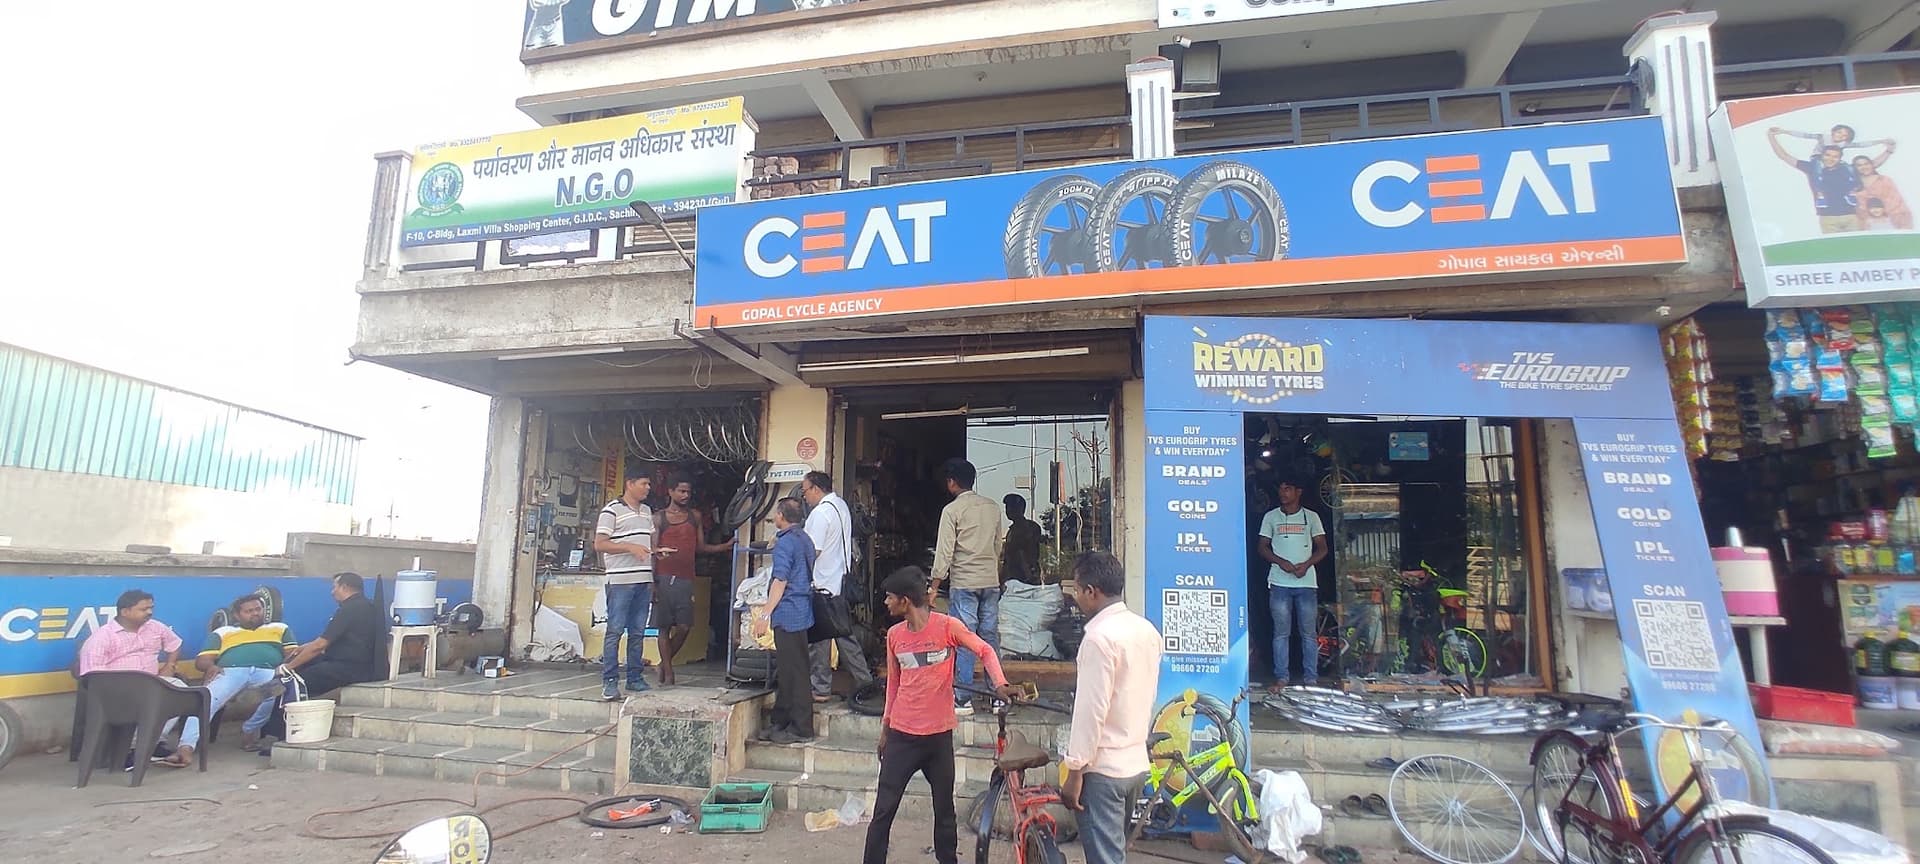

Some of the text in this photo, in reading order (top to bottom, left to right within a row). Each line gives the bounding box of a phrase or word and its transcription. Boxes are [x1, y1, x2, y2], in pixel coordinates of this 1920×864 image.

[473, 120, 737, 178] पर्यावरण और मानव अधिकार संस्था
[1216, 168, 1260, 185] MILAZE
[555, 168, 635, 206] N.G.O
[1351, 144, 1611, 228] CEAT
[456, 226, 482, 238] Laxmi
[483, 224, 502, 235] Villa
[503, 220, 541, 234] Shopping
[542, 216, 572, 229] Center,
[1279, 218, 1289, 249] CEAT
[744, 199, 947, 279] CEAT
[1181, 219, 1191, 261] CEAT
[1103, 230, 1111, 266] CEAT
[1438, 245, 1625, 271] ગોપાલ સાયકલ એજન્સી
[1775, 267, 1920, 287] SHREE AMBEY P
[742, 298, 883, 321] GOPAL CYCLE AGENCY
[1193, 342, 1324, 373] REWARD
[1512, 352, 1554, 364] TVS
[1478, 363, 1630, 383] EUROGRIP
[1194, 374, 1324, 390] WINNING TYRES
[1500, 381, 1613, 392] THE BIKE TYRE SPECIALIST
[1183, 426, 1201, 435] BUY
[1147, 436, 1237, 446] TVS EUROGRIP TYRES
[1616, 434, 1635, 442] BUY
[1154, 447, 1161, 455] &
[1163, 447, 1180, 456] WIN
[1581, 442, 1677, 453] TVS EUROGRIP TYRES
[1592, 453, 1598, 462] &
[1600, 454, 1618, 462] WIN
[1162, 465, 1226, 478] BRAND
[1603, 472, 1672, 485] BRAND
[1167, 500, 1218, 513] GOLD
[1617, 507, 1672, 521] GOLD
[1177, 533, 1209, 545] IPL
[1634, 541, 1670, 554] IPL
[1635, 554, 1676, 562] TICKETS
[1175, 575, 1214, 586] SCAN
[1643, 585, 1686, 597] SCAN
